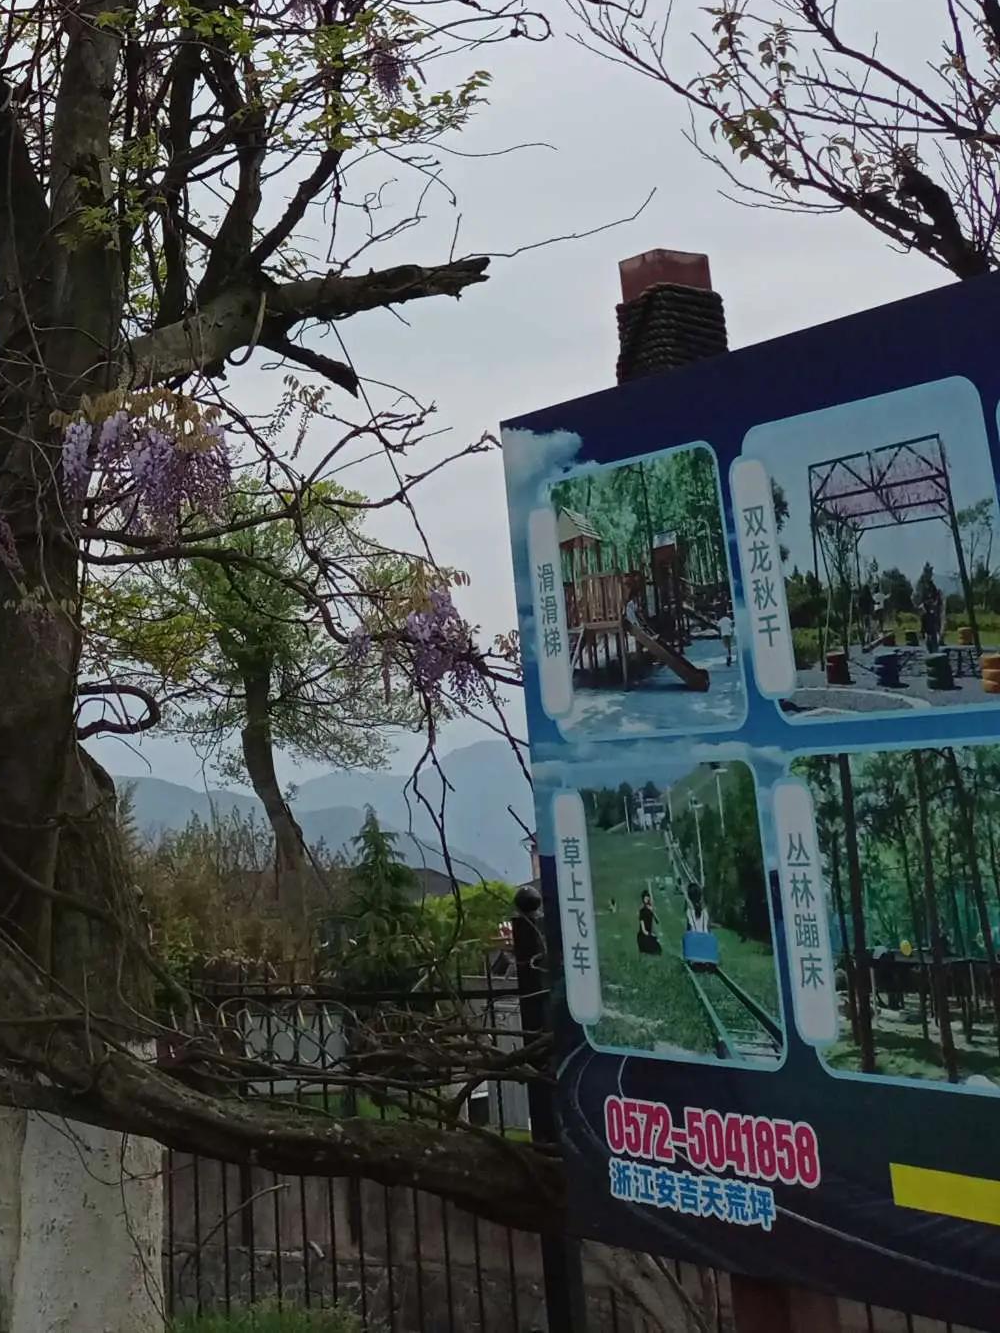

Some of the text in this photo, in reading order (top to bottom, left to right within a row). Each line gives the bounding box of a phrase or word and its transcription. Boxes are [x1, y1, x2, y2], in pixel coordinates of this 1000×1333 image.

[537, 563, 562, 657] 滑滑梯
[562, 837, 591, 975] 草上飞车
[786, 833, 824, 990] 丛林蹦床
[605, 1096, 820, 1186] 0572-5041858
[610, 1160, 774, 1229] 浙江安吉天荒坪
